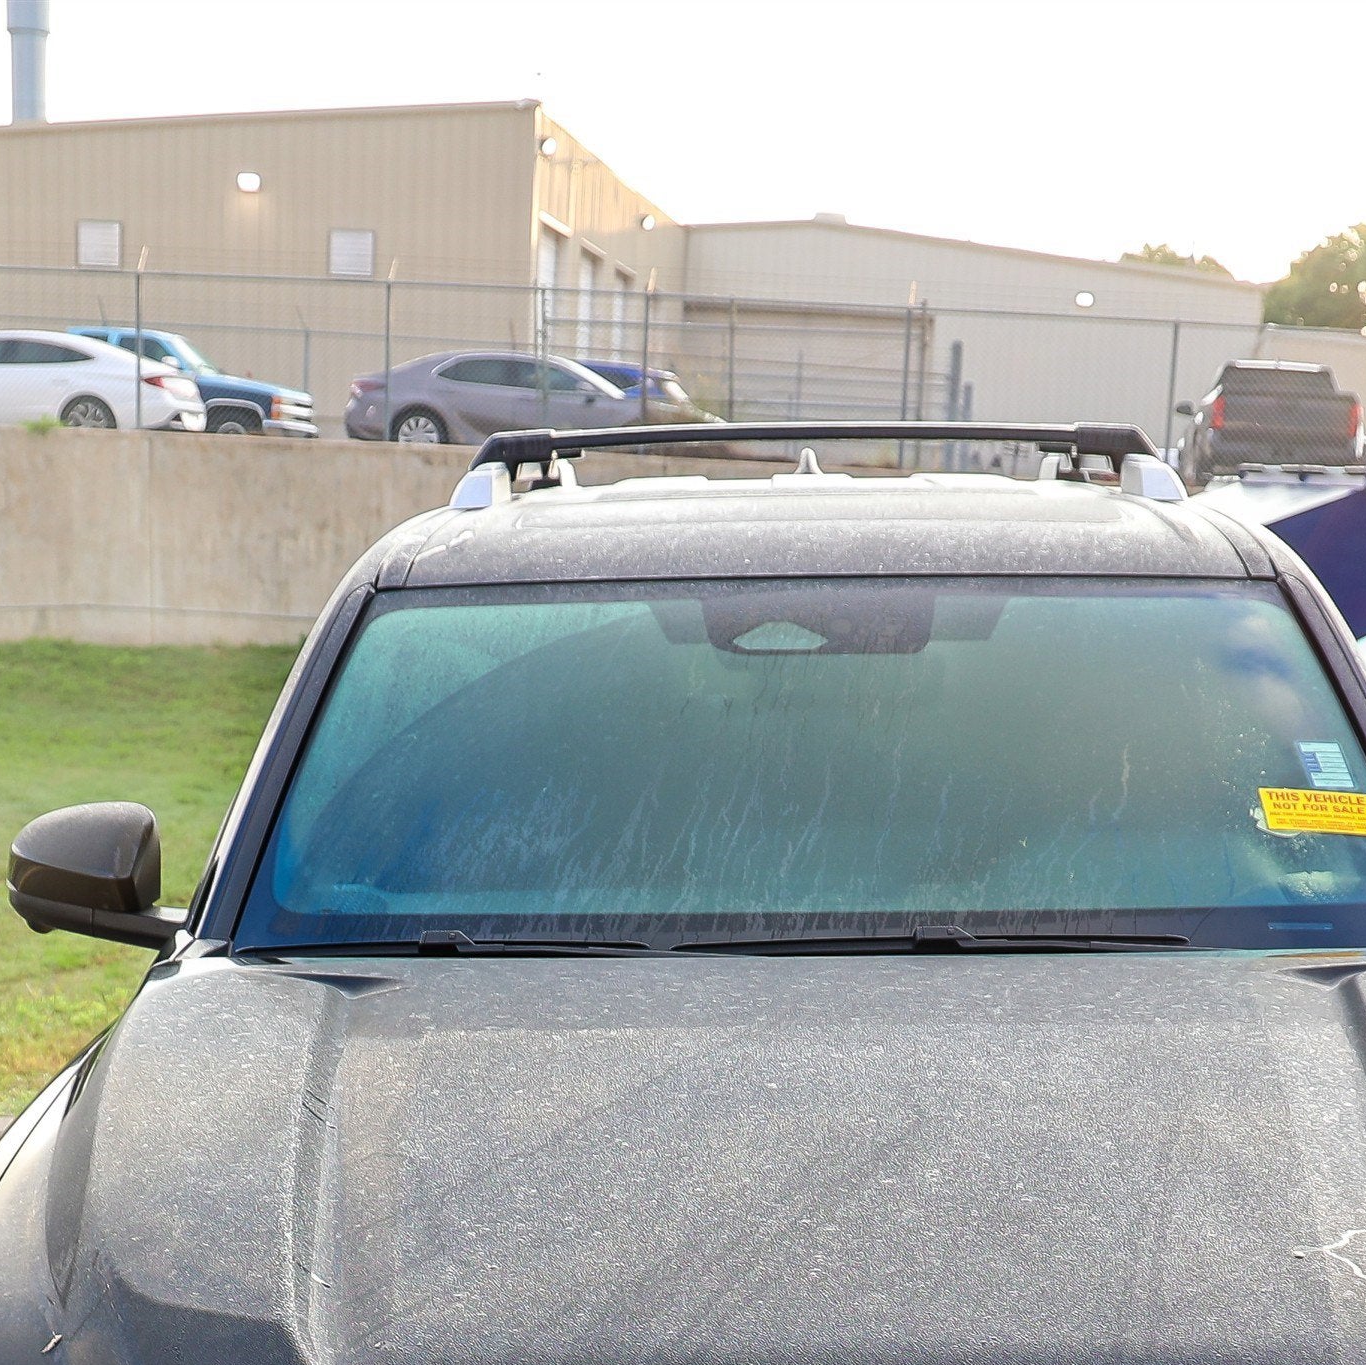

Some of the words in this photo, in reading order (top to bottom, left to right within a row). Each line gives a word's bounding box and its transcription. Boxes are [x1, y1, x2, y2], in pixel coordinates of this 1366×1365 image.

[1266, 791, 1299, 801] THIS
[1304, 793, 1366, 805] VEHICLE
[1273, 802, 1298, 811] NOT
[1302, 803, 1328, 811] FOR
[1333, 805, 1365, 814] SALE
